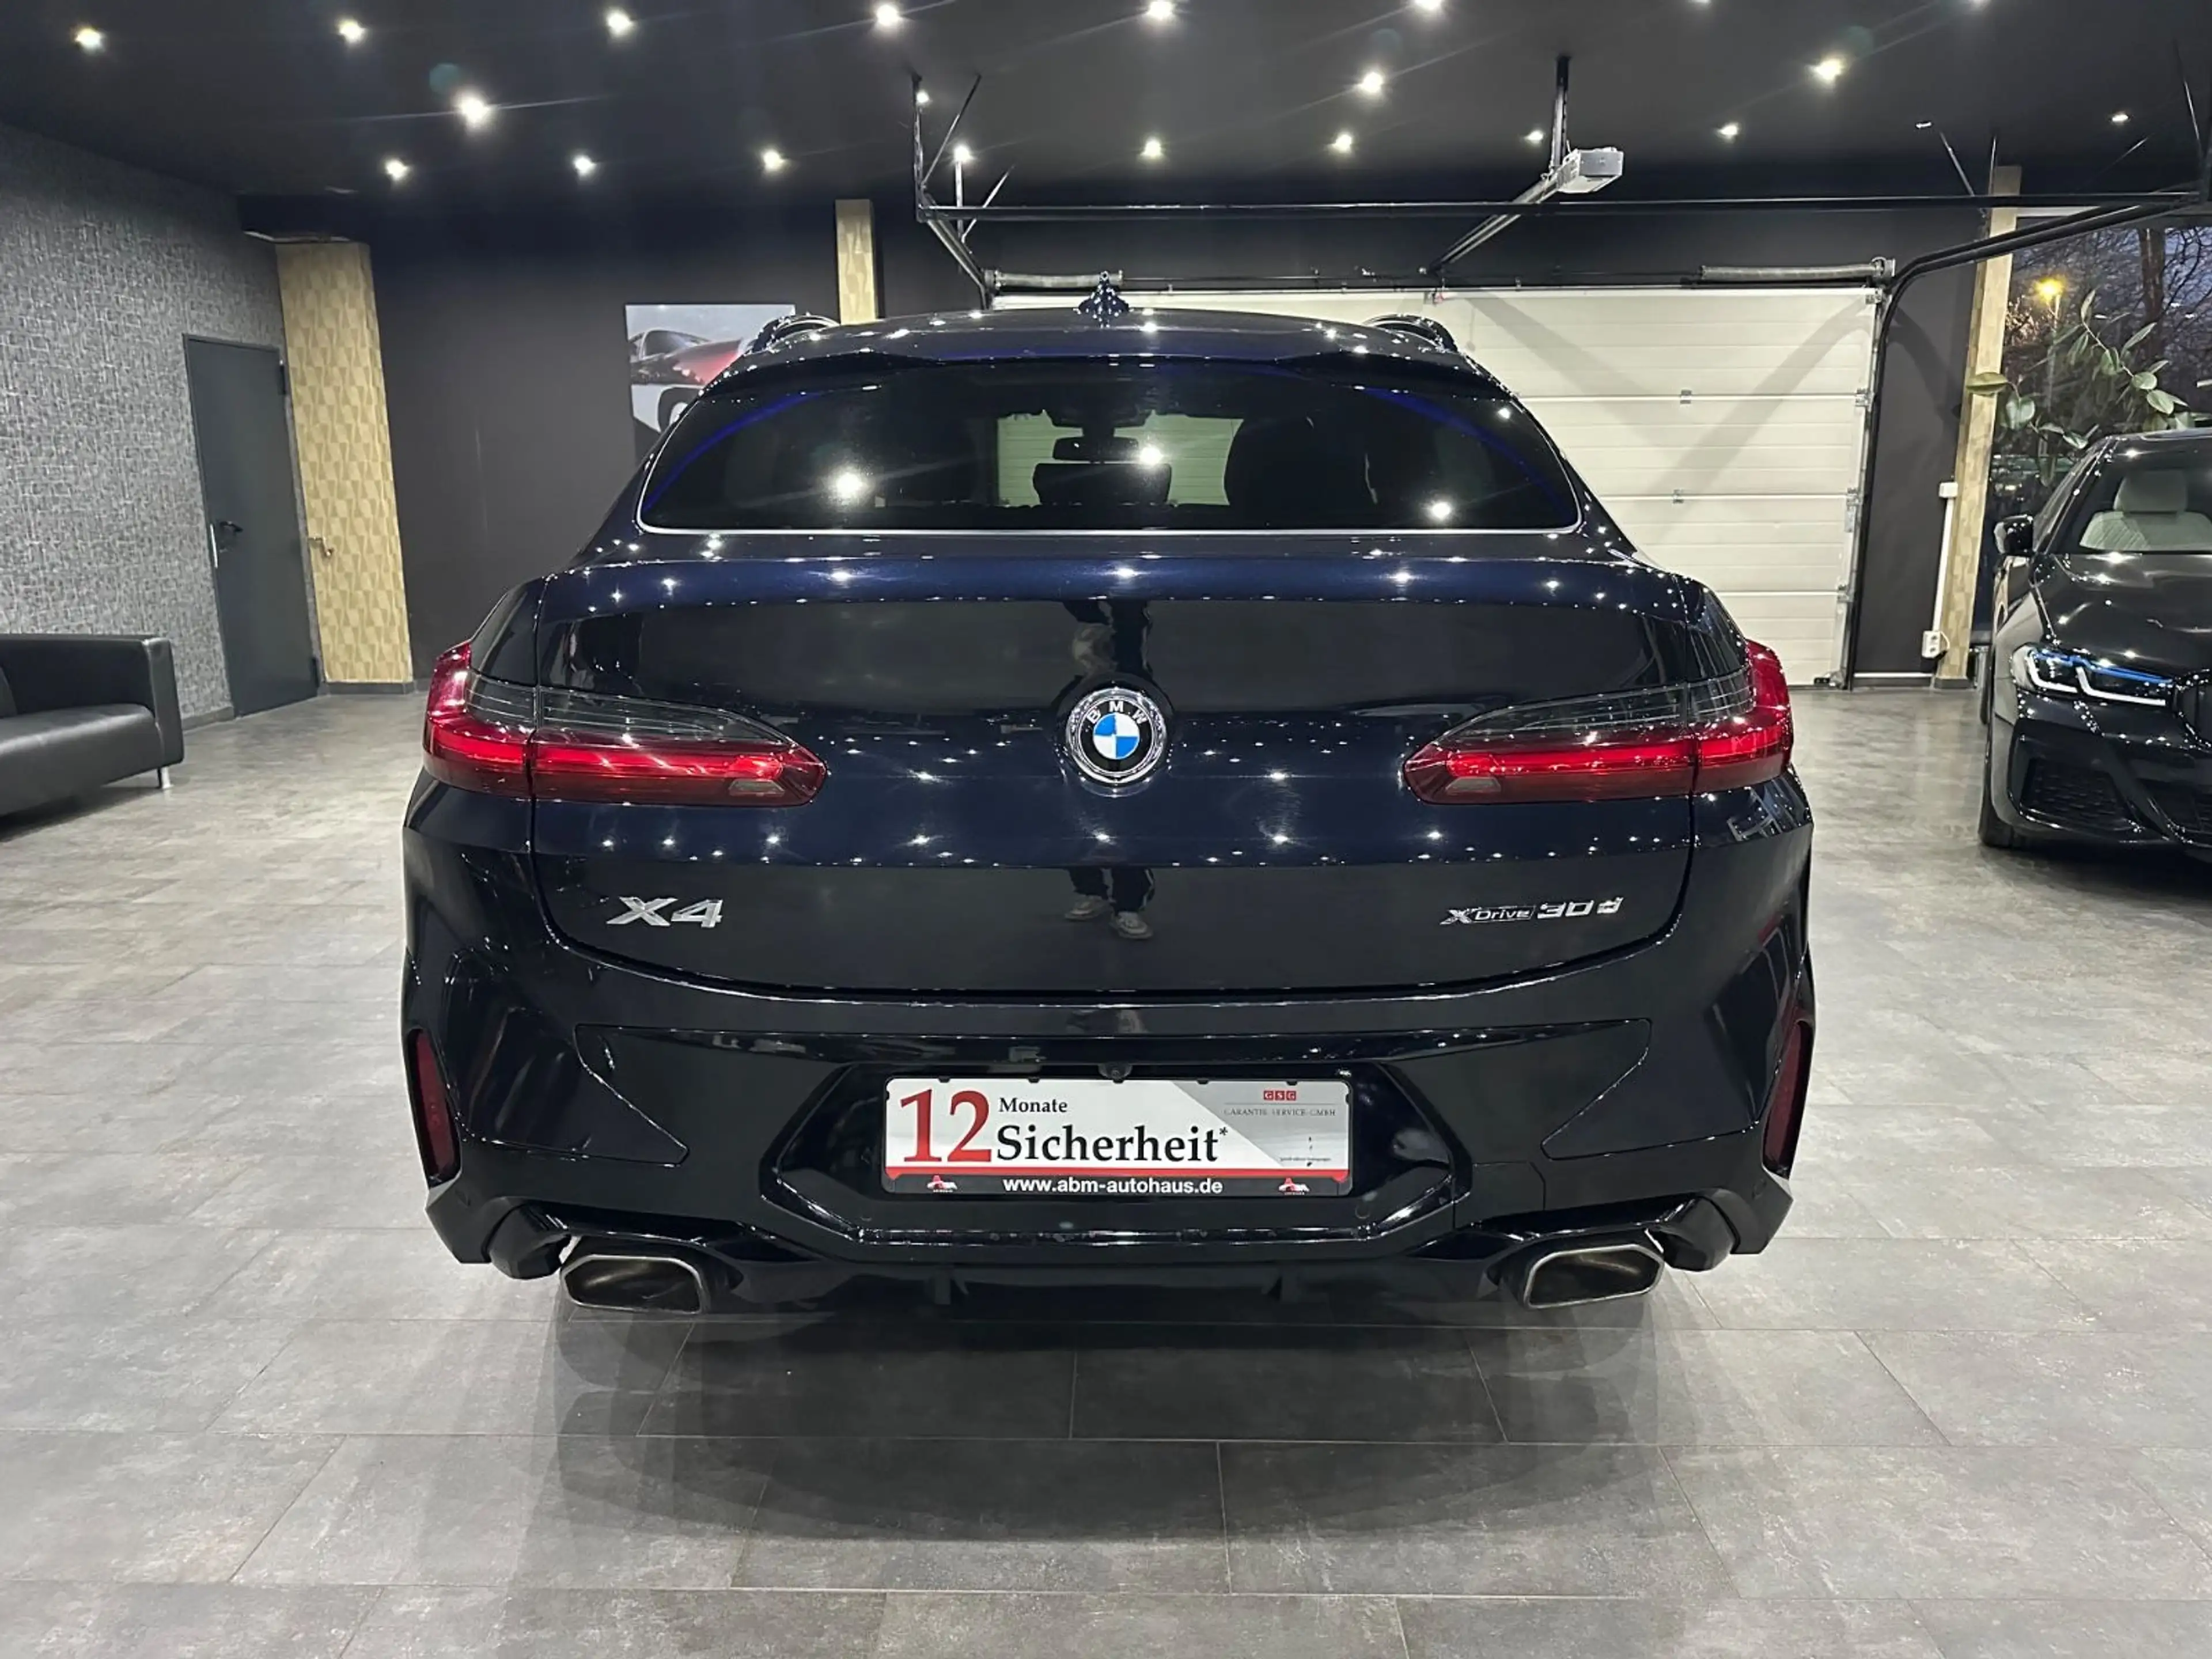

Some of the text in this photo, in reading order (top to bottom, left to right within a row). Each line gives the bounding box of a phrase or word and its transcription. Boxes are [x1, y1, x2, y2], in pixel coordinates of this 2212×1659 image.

[1086, 700, 1149, 725] BMW
[606, 896, 724, 928] X4
[998, 1097, 1068, 1113] Monate
[900, 1089, 992, 1162] 12
[1003, 1177, 1223, 1194] www.abm-autohaus.de
